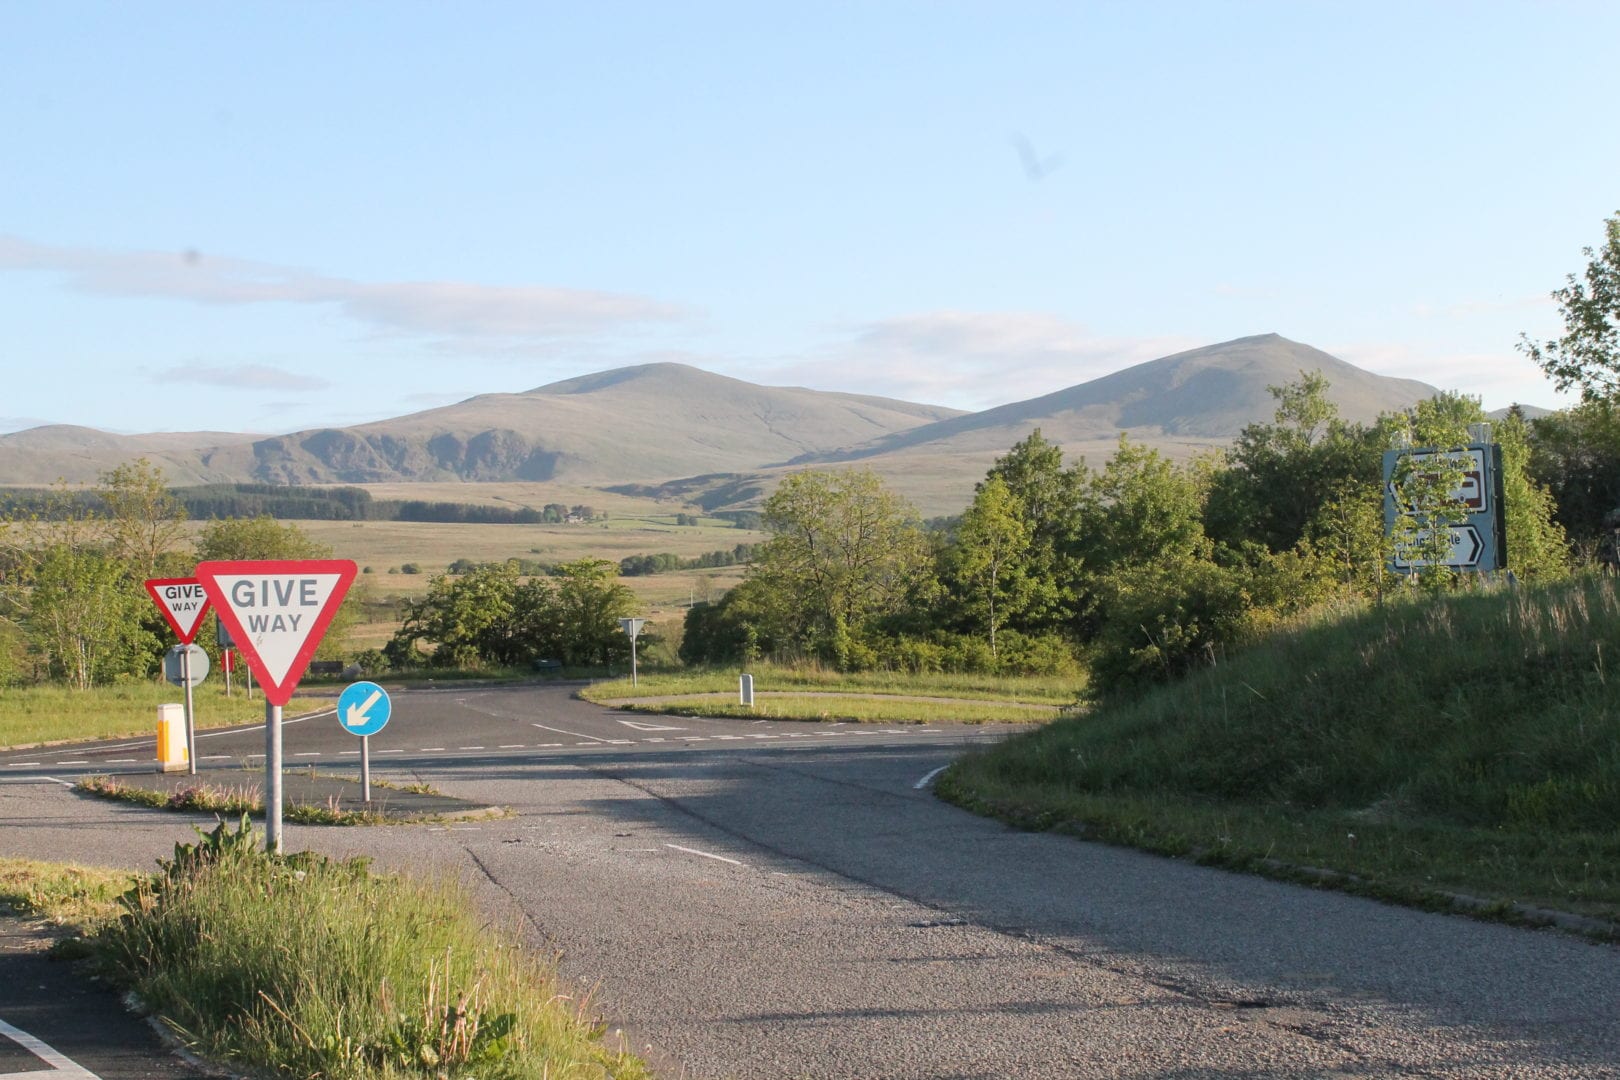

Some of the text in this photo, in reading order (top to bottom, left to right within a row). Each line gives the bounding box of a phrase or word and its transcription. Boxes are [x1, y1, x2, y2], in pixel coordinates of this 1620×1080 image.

[165, 585, 203, 600] GIVE
[231, 579, 318, 608] GIVE
[172, 602, 198, 612] WAY
[248, 614, 302, 633] WAY
